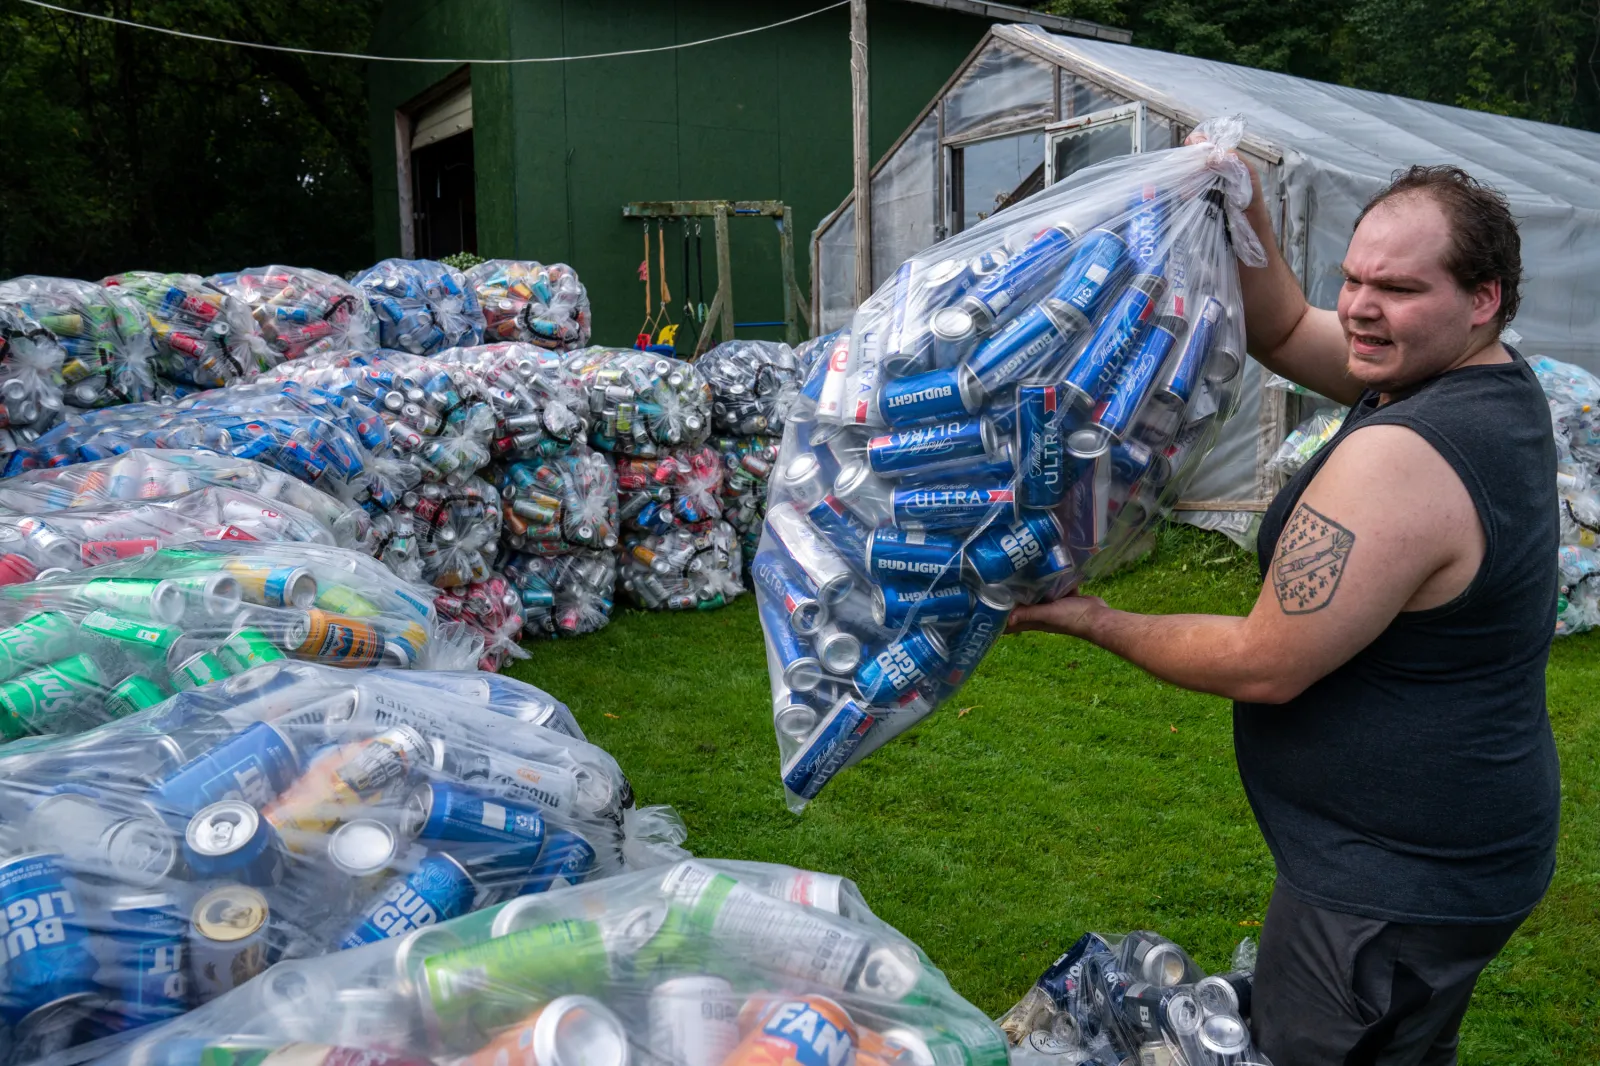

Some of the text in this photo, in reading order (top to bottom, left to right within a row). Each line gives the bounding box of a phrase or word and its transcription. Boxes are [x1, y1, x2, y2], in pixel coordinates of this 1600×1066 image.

[858, 331, 878, 395] ULTRA
[994, 332, 1054, 383] BUD LIGHT
[1097, 326, 1142, 383] ULTRA
[887, 385, 953, 408] BUD LIGHT
[898, 421, 961, 446] ULTRA
[1029, 431, 1043, 479] Michelob
[1043, 418, 1059, 486] ULTRA
[914, 489, 984, 508] ULTRA
[924, 482, 971, 492] Michelob
[999, 534, 1030, 571] BUD
[1007, 519, 1043, 562] IGHT
[878, 558, 947, 574] BUD LIGHT
[897, 585, 962, 603] BUD LIGHT
[886, 642, 927, 685] LIGH
[955, 622, 994, 666] ULTRA
[876, 651, 911, 691] BUD
[813, 739, 859, 785] ULTRA
[0, 890, 76, 938] LIG
[383, 881, 438, 930] BUD
[0, 916, 66, 966] BU
[765, 1001, 853, 1066] FAN
